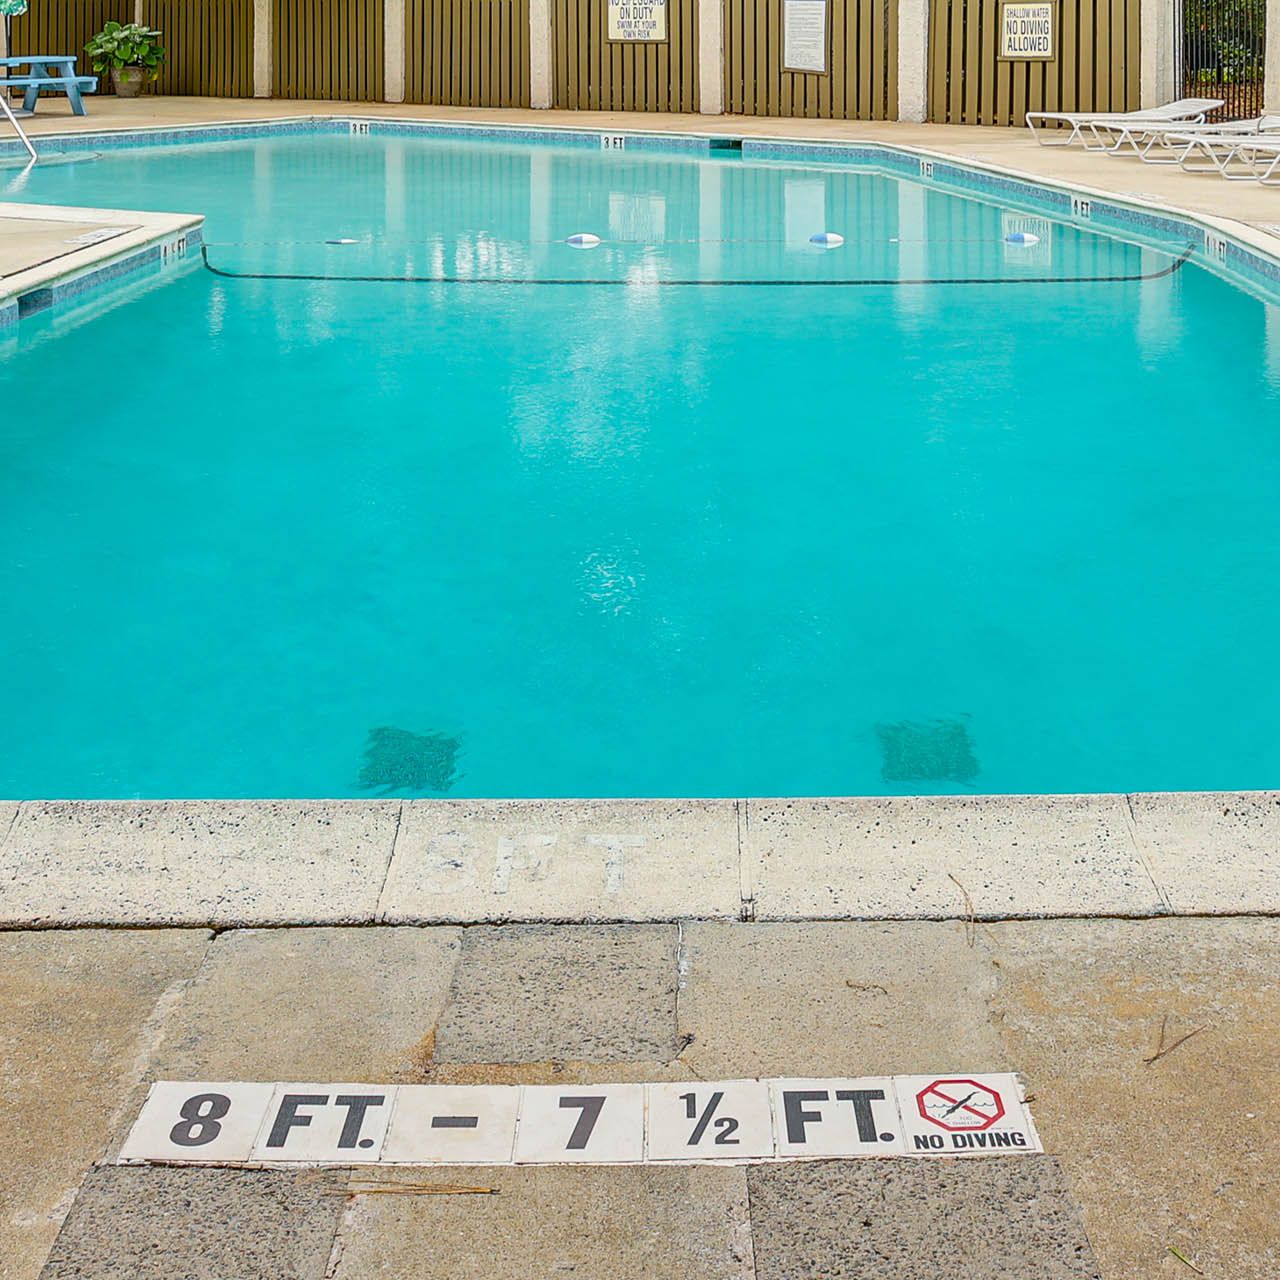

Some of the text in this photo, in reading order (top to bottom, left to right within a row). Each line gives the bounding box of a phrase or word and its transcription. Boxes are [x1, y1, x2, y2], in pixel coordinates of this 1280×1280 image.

[620, 6, 654, 20] ON DUTY
[616, 20, 632, 29] SWIM
[633, 20, 640, 29] AT
[1006, 19, 1049, 35] NO DIVING
[1007, 36, 1049, 52] ALLOWED
[613, 136, 624, 148] FT
[169, 1093, 232, 1147] 8
[265, 1094, 385, 1149] FT.
[558, 1096, 607, 1150] 7
[782, 1089, 896, 1144] FT.
[913, 1132, 1027, 1150] NO DIVING
